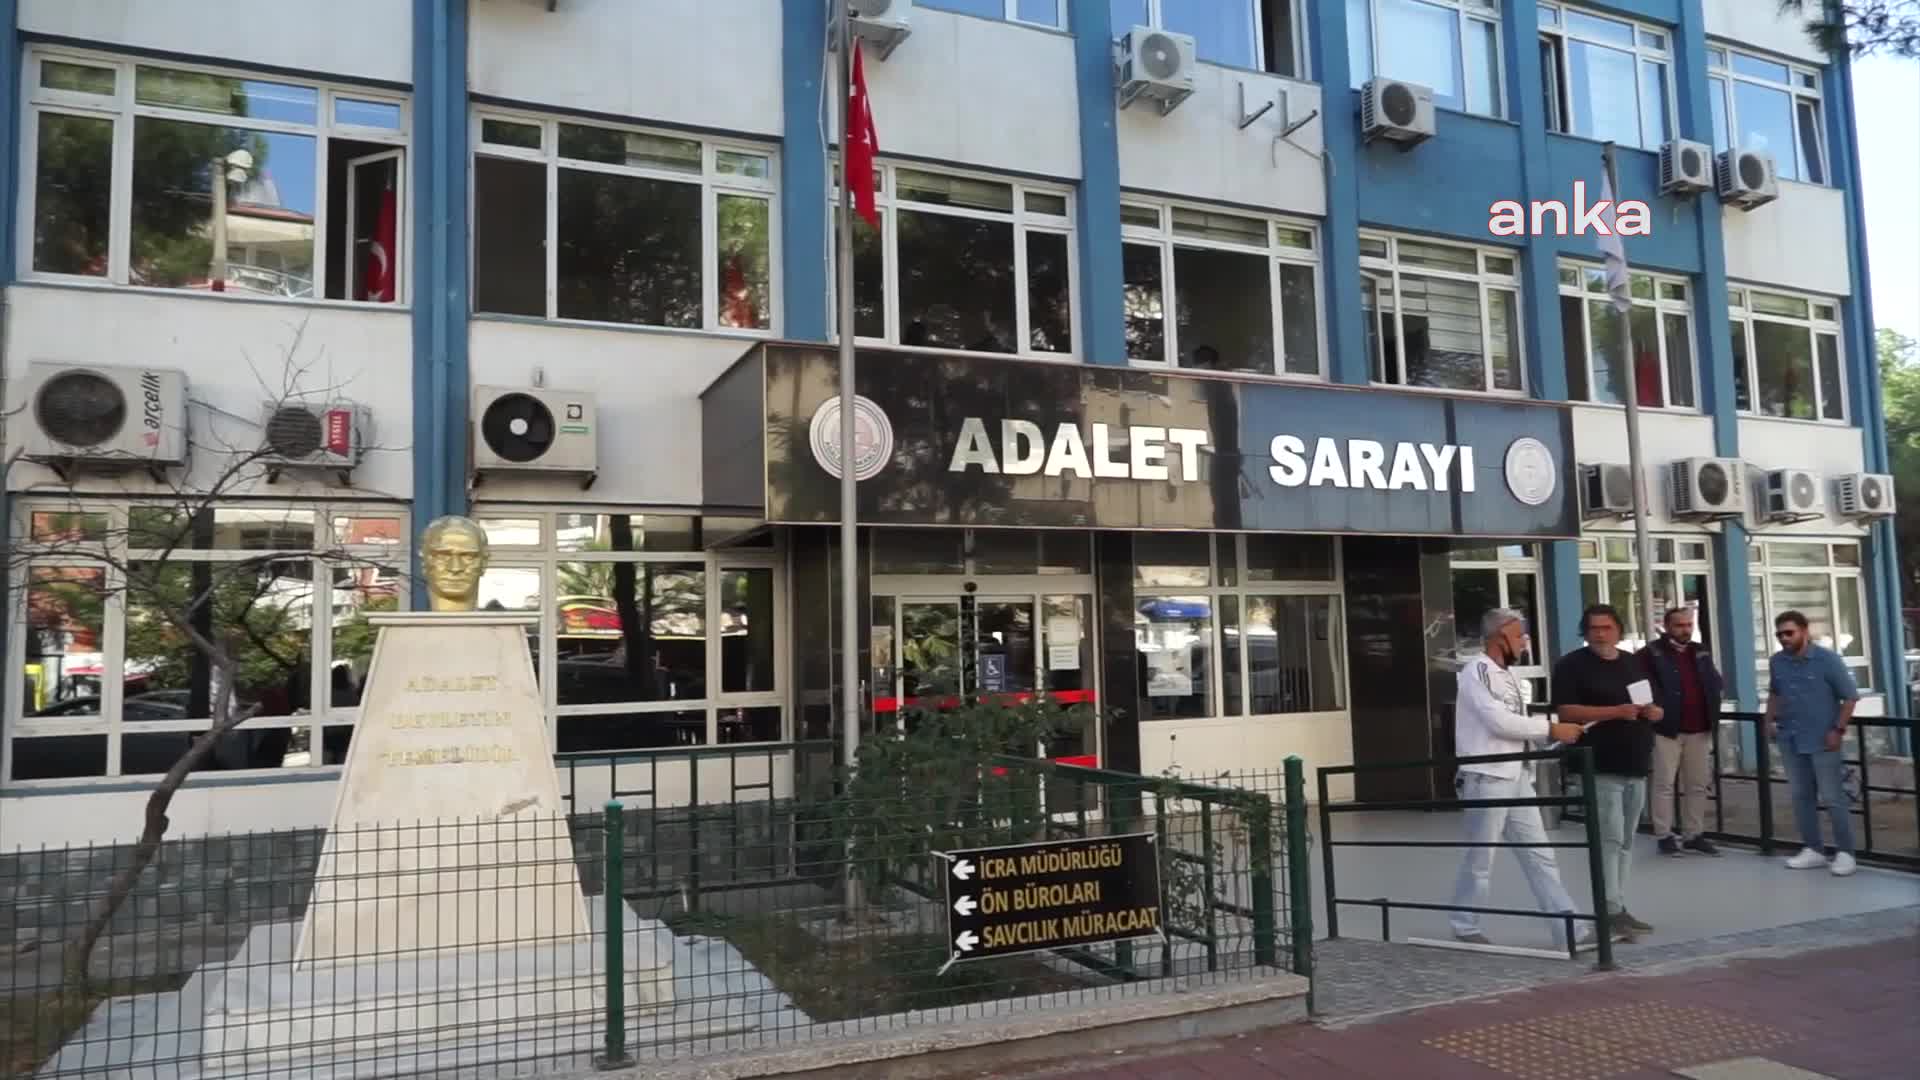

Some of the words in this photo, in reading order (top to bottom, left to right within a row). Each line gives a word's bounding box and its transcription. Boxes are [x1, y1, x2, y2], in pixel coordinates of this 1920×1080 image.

[141, 369, 164, 429] arçelik
[948, 417, 1209, 482] ADALET
[1268, 434, 1476, 493] SARAYI
[980, 855, 1017, 880] İCRA
[1021, 843, 1122, 875] MÜDÜRLÜĞÜ
[980, 887, 1009, 915] ÖN
[1013, 880, 1100, 911] BÜROLARI
[983, 919, 1060, 948] SAVCILIK
[1063, 907, 1158, 939] MÜRACAAT
